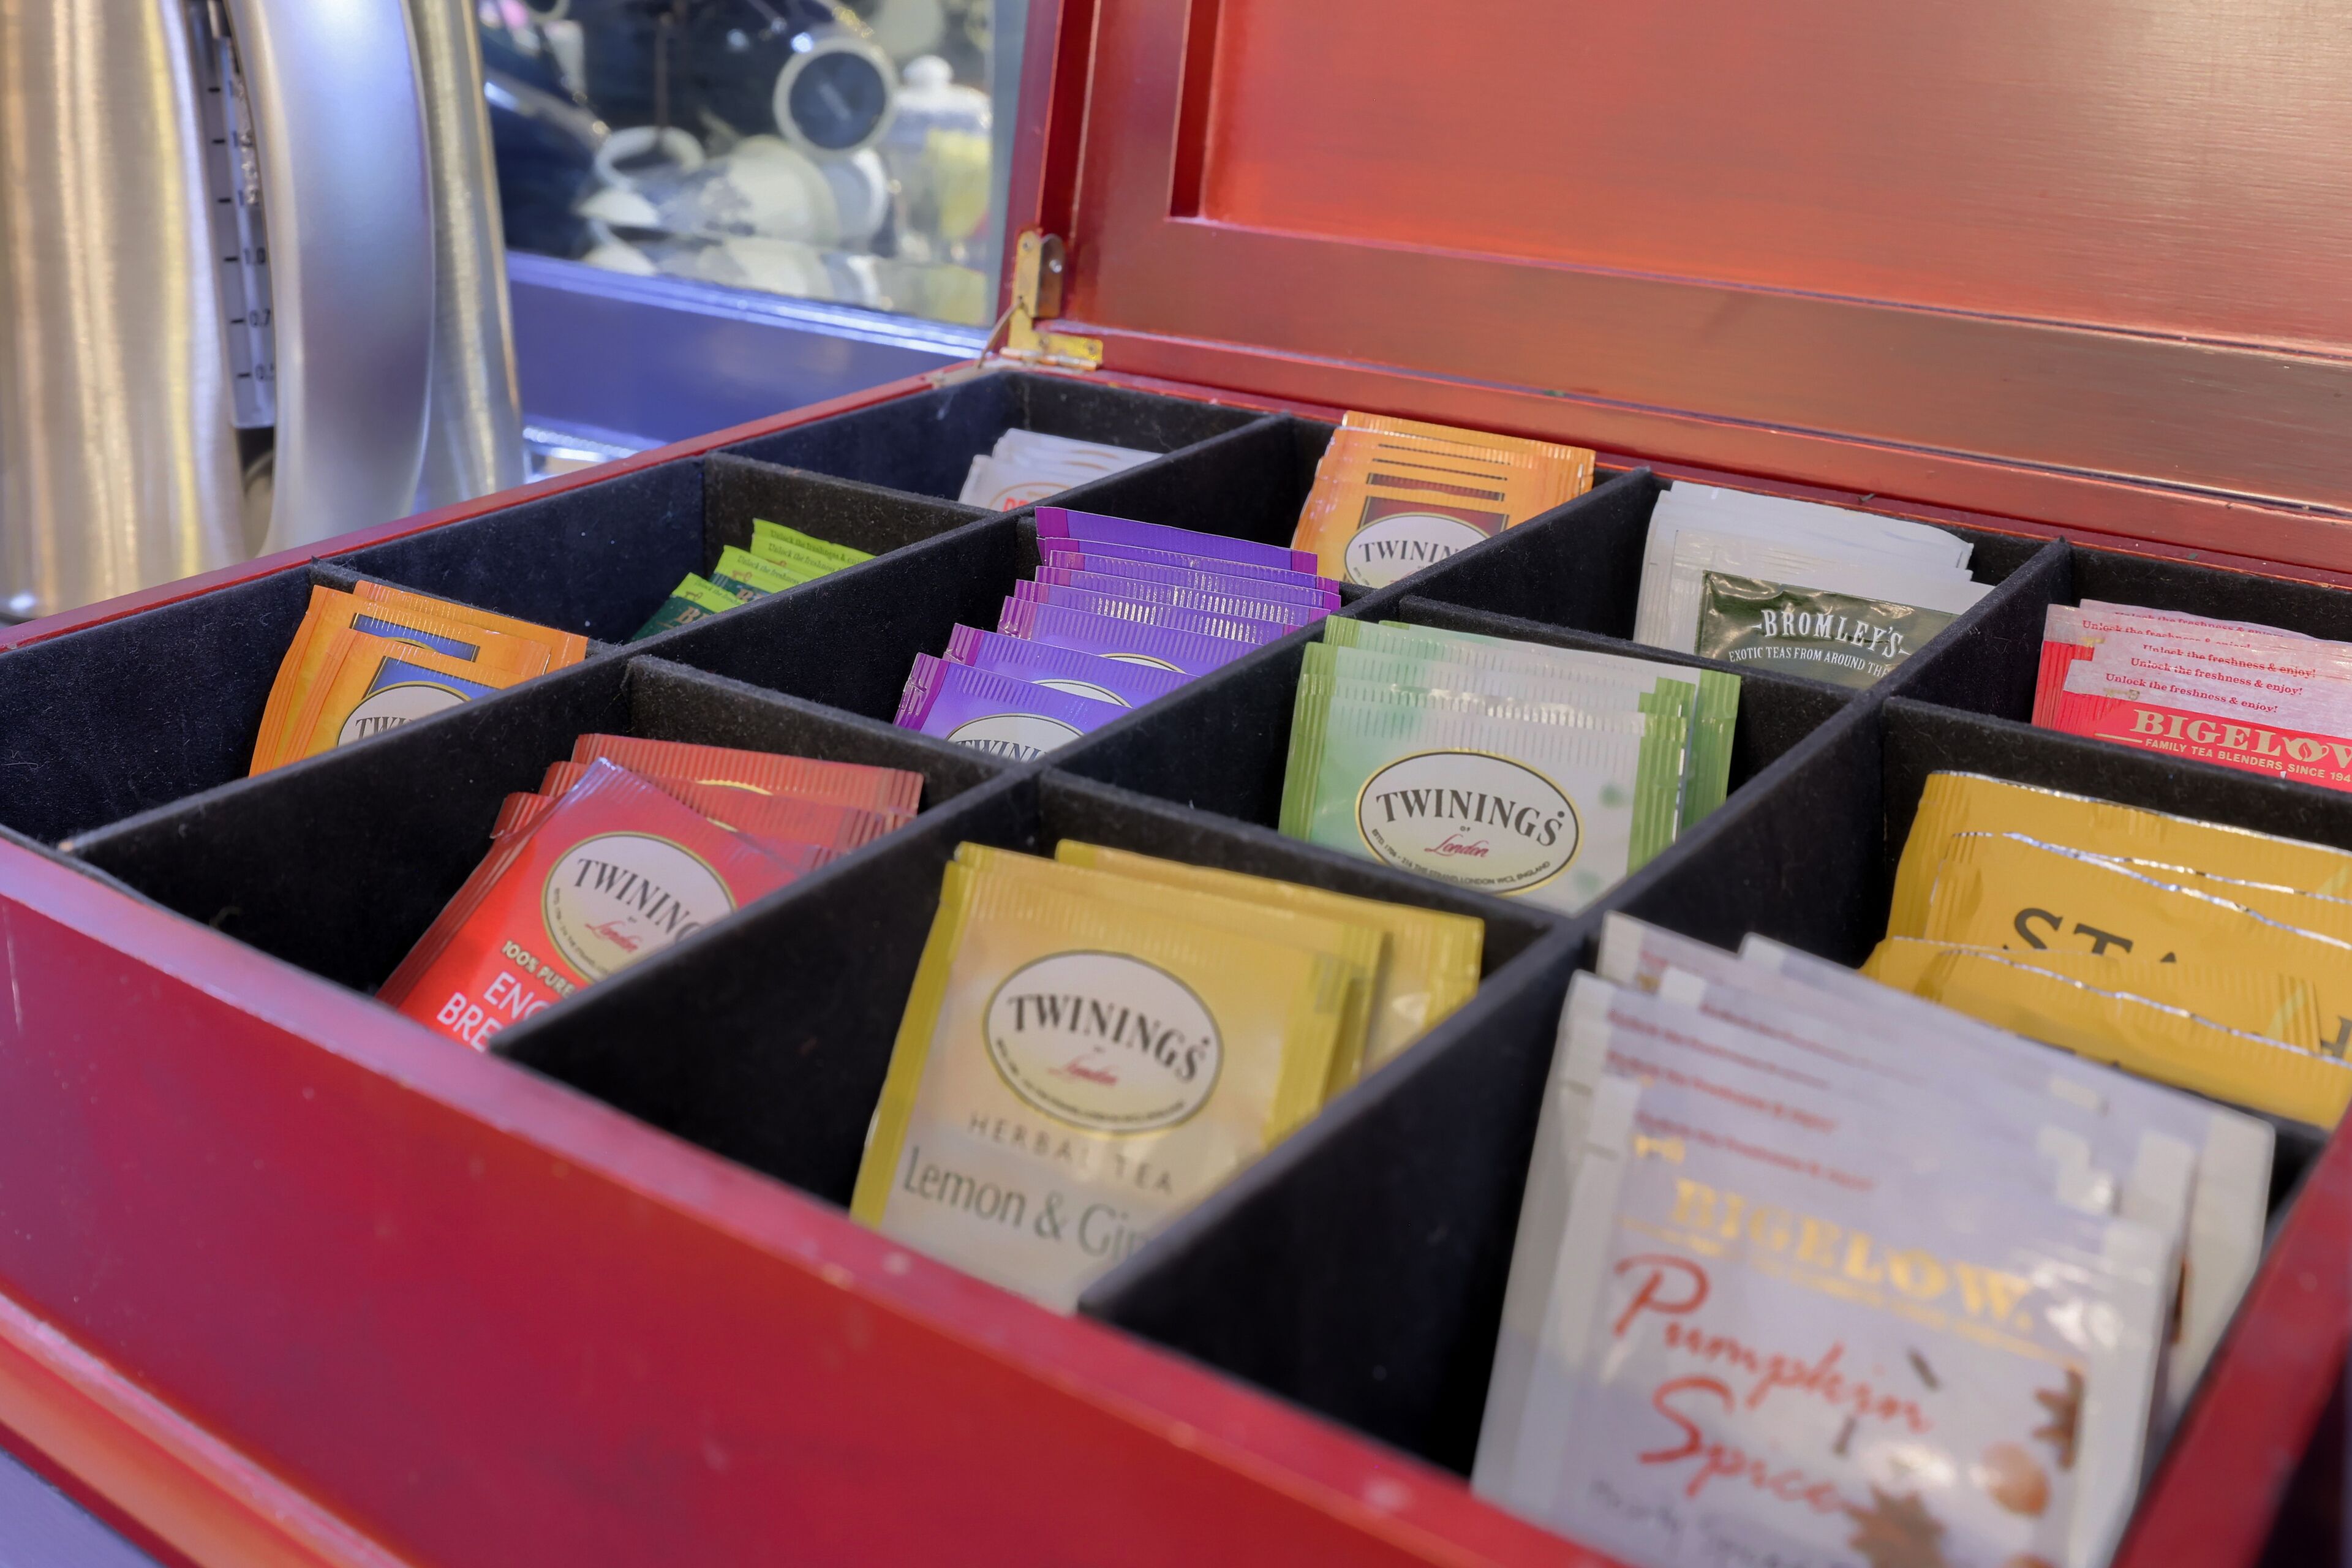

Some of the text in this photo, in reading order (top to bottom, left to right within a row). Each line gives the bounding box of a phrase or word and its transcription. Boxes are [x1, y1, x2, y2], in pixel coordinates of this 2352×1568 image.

[1762, 609, 1903, 658] BROMLEY'S
[1728, 647, 1763, 662] EXOTIC
[1768, 647, 1792, 659] TEAS
[1794, 648, 1822, 662] FROM
[1825, 653, 1866, 671] AROUND
[2131, 658, 2303, 696] Unlock the freshness & enjoy!
[2106, 673, 2146, 687] Unlock
[2149, 681, 2168, 691] the
[2170, 685, 2226, 703] freshness
[2241, 700, 2278, 713] enjoy!
[2145, 738, 2352, 784] FAMILY TEA BLENDERS SINCE 194
[1424, 834, 1490, 858] London
[502, 941, 540, 974] 100%
[902, 1145, 1027, 1227] Lemon
[1034, 1191, 1065, 1242] &
[1612, 1253, 1934, 1434] Pumpkin
[1638, 1374, 1840, 1514] Spice
